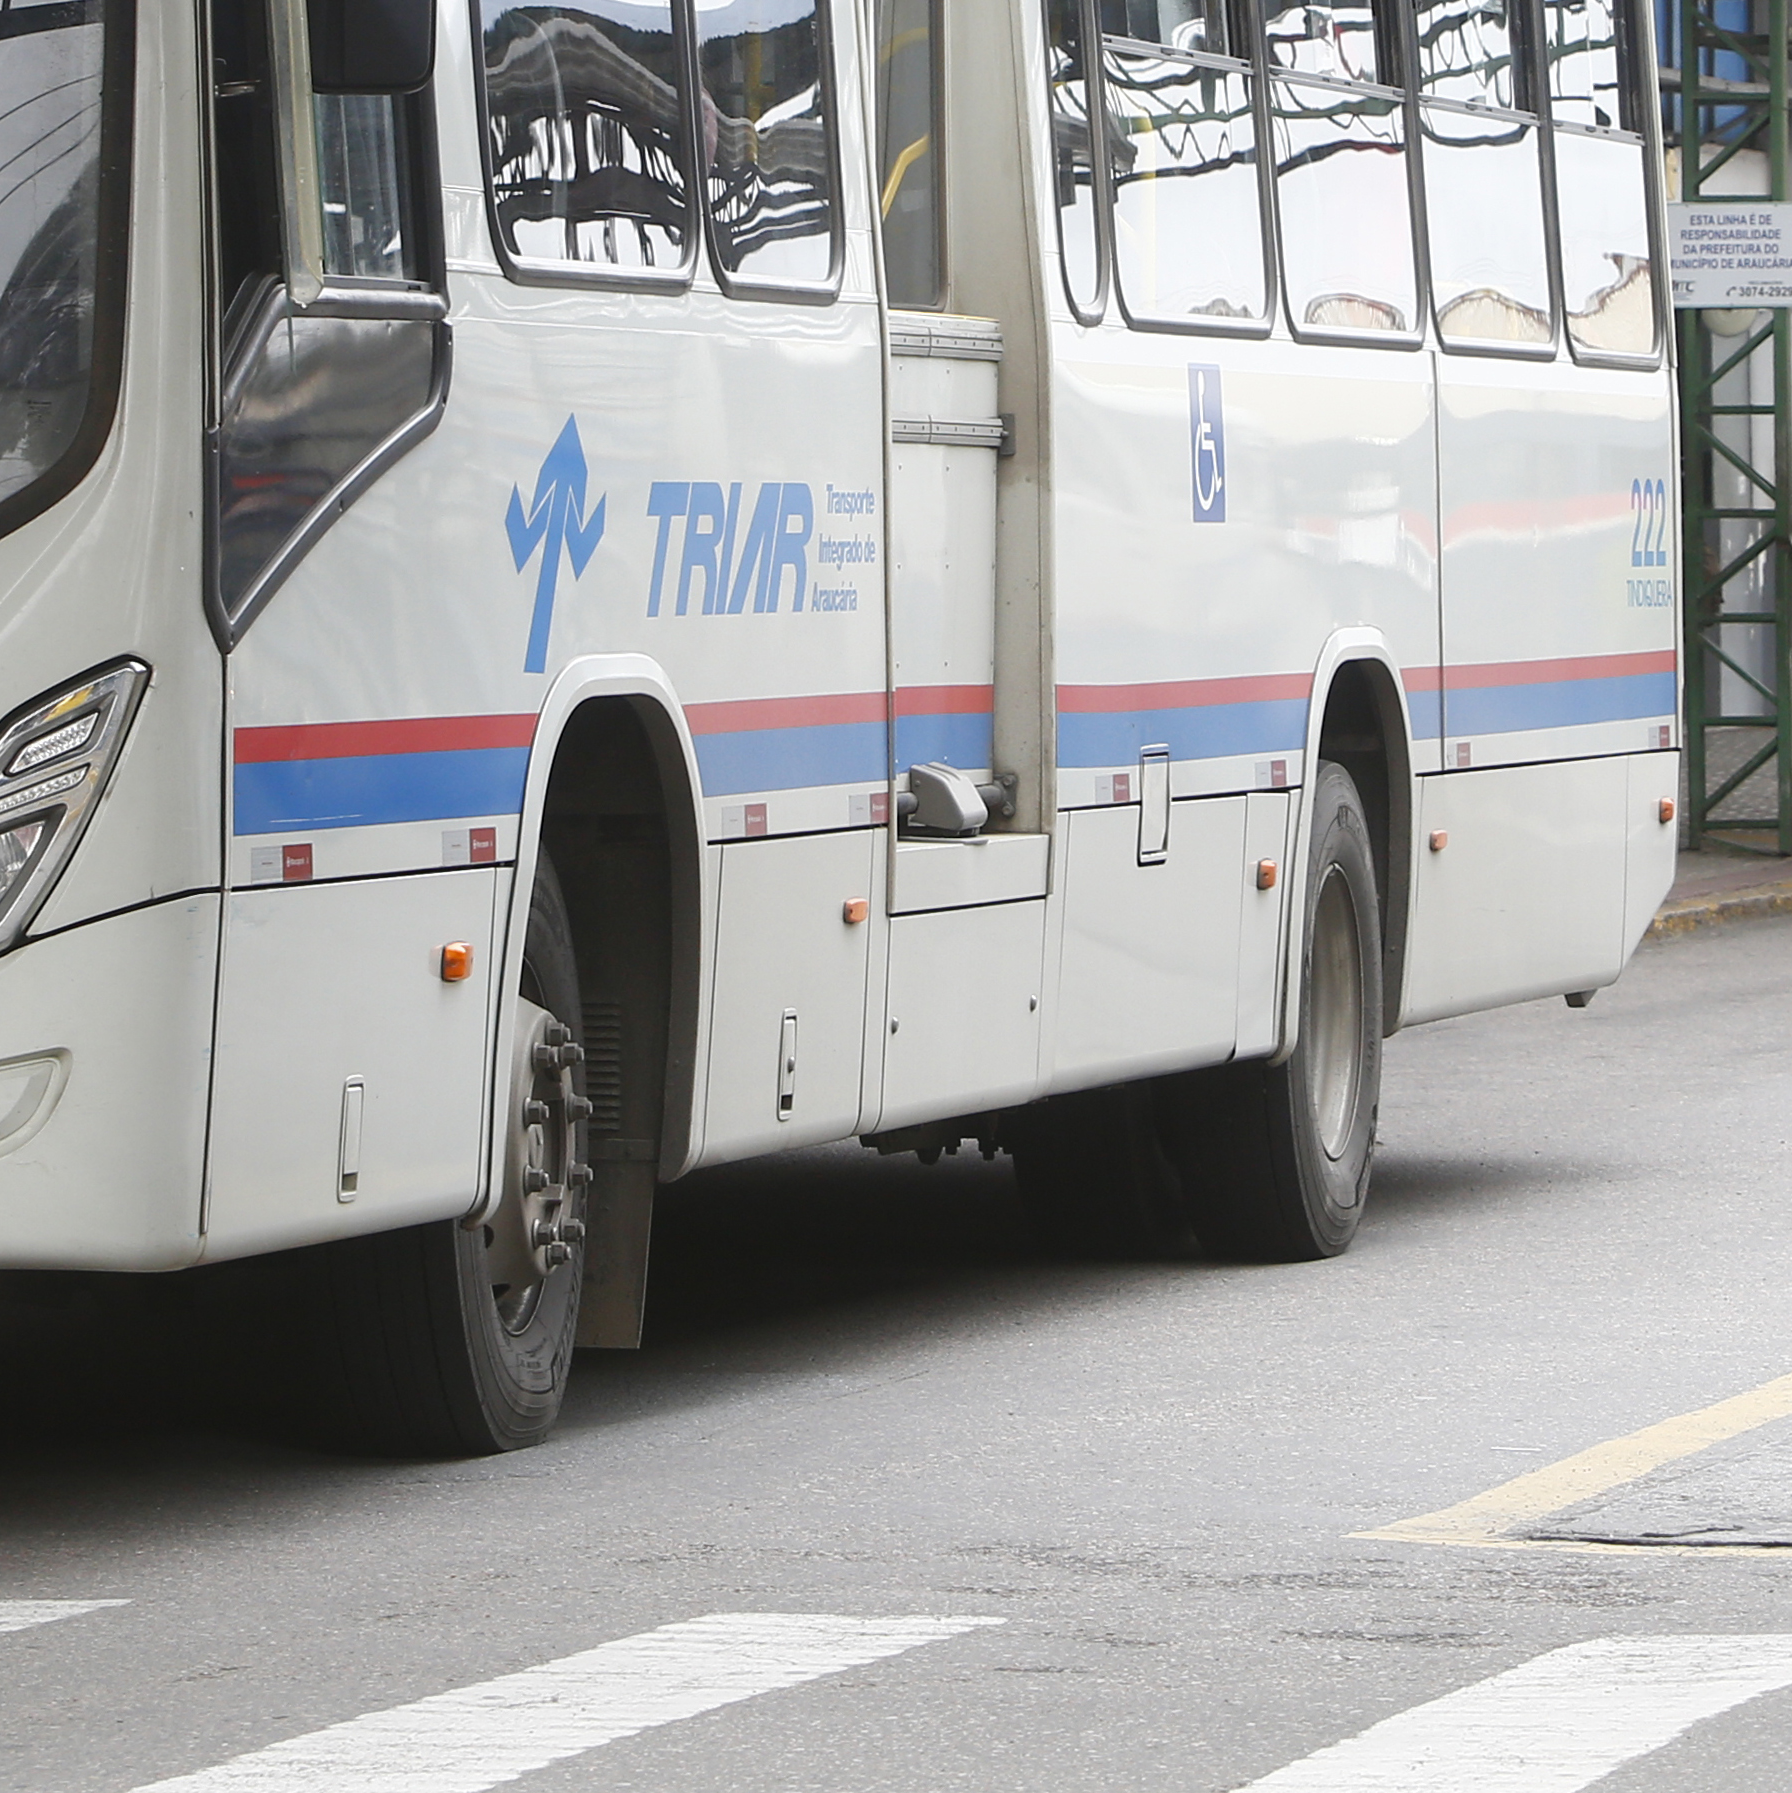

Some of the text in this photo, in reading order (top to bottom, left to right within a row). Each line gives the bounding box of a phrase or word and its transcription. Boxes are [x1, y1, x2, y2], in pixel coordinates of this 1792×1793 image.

[1680, 229, 1782, 240] RESPONSABILIDADE
[1690, 212, 1773, 226] ESTA LINHA É DE
[1683, 244, 1779, 255] DA PREFEITURA DO
[1721, 258, 1735, 269] DE
[825, 483, 876, 522] Transporte
[1631, 478, 1667, 567] 222
[646, 481, 815, 618] TRIAR
[818, 533, 876, 572] Integrado de
[810, 580, 858, 614] Araucária
